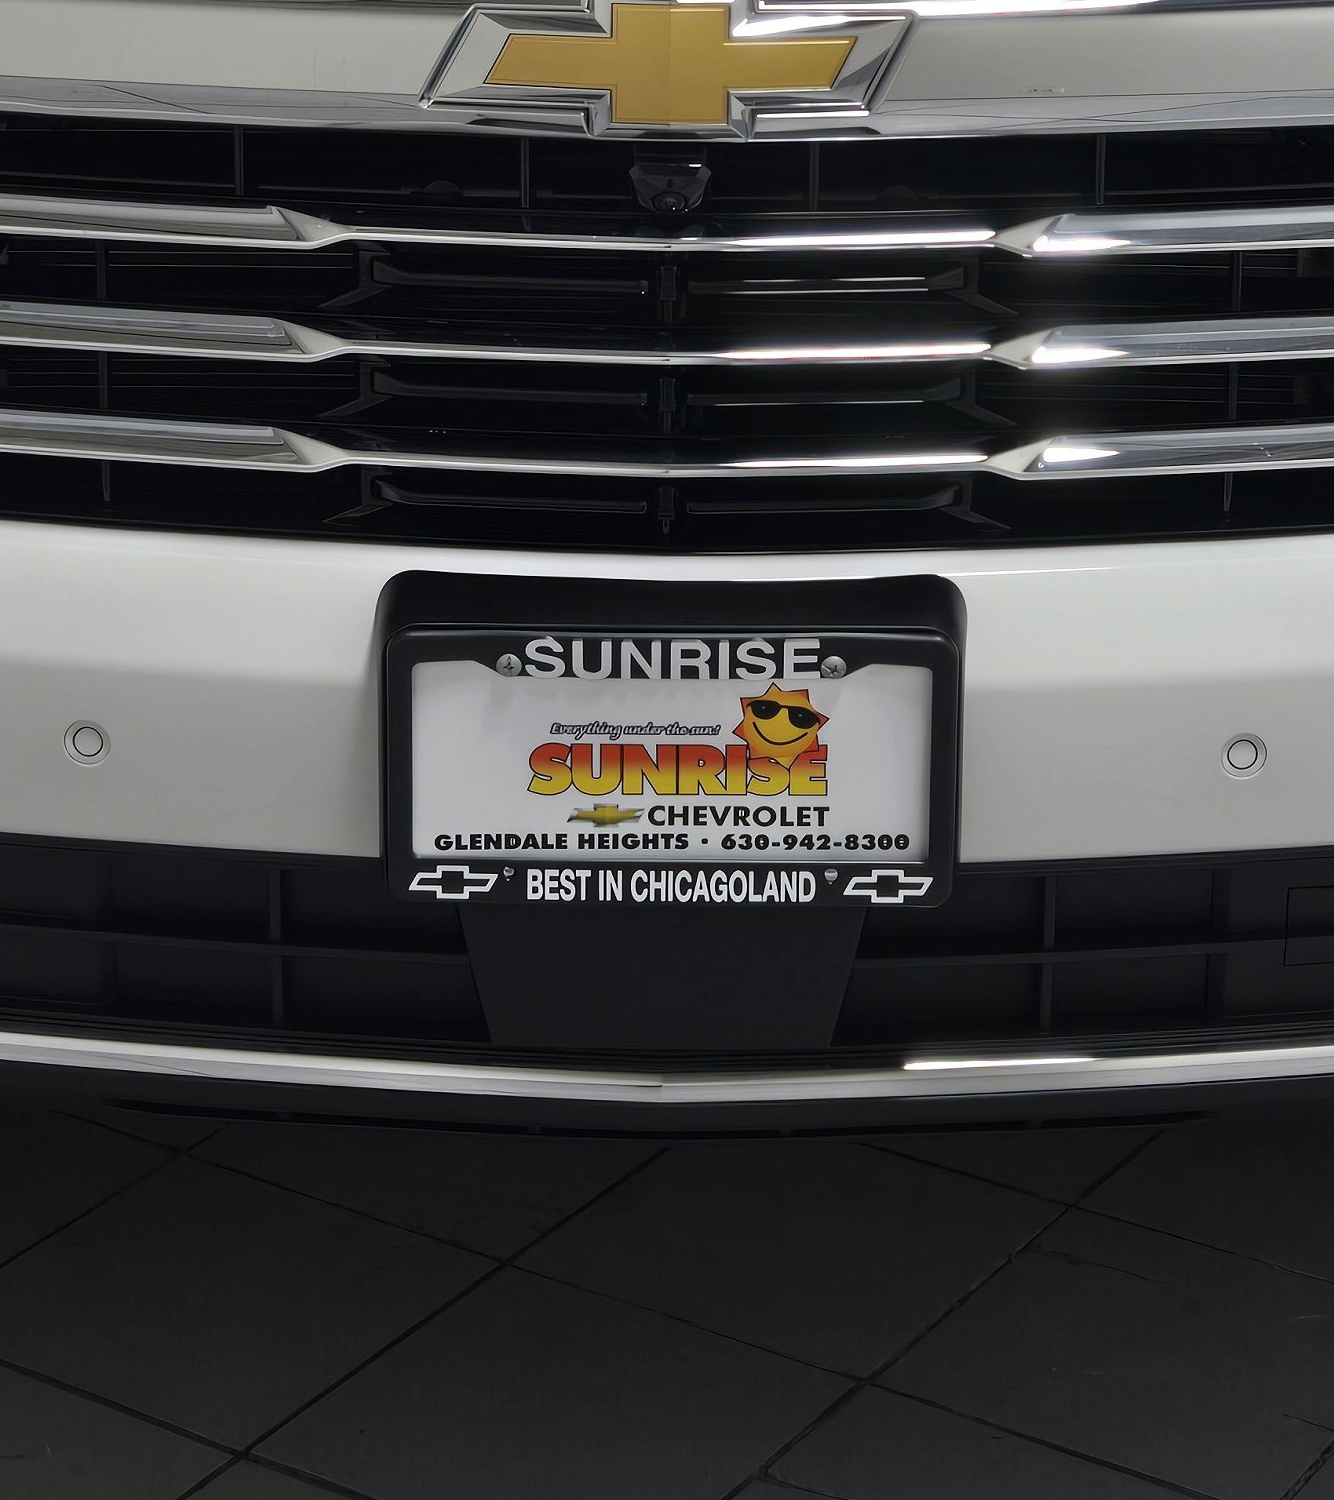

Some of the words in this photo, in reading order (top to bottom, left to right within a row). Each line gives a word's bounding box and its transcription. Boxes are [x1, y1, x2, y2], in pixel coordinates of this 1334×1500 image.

[524, 637, 821, 680] SUNRISE
[549, 720, 624, 740] Everything
[623, 722, 666, 736] under
[665, 722, 689, 736] the
[688, 724, 721, 736] sun!
[527, 742, 828, 796] SUNRISE
[648, 805, 829, 827] CHEVROLET
[434, 833, 568, 852] GLENDALE
[578, 833, 690, 851] HEIGHTS
[721, 833, 910, 851] 630-942-8300
[527, 869, 592, 901] BEST
[598, 869, 623, 901] IN
[630, 869, 816, 902] CHICAGOLAND
